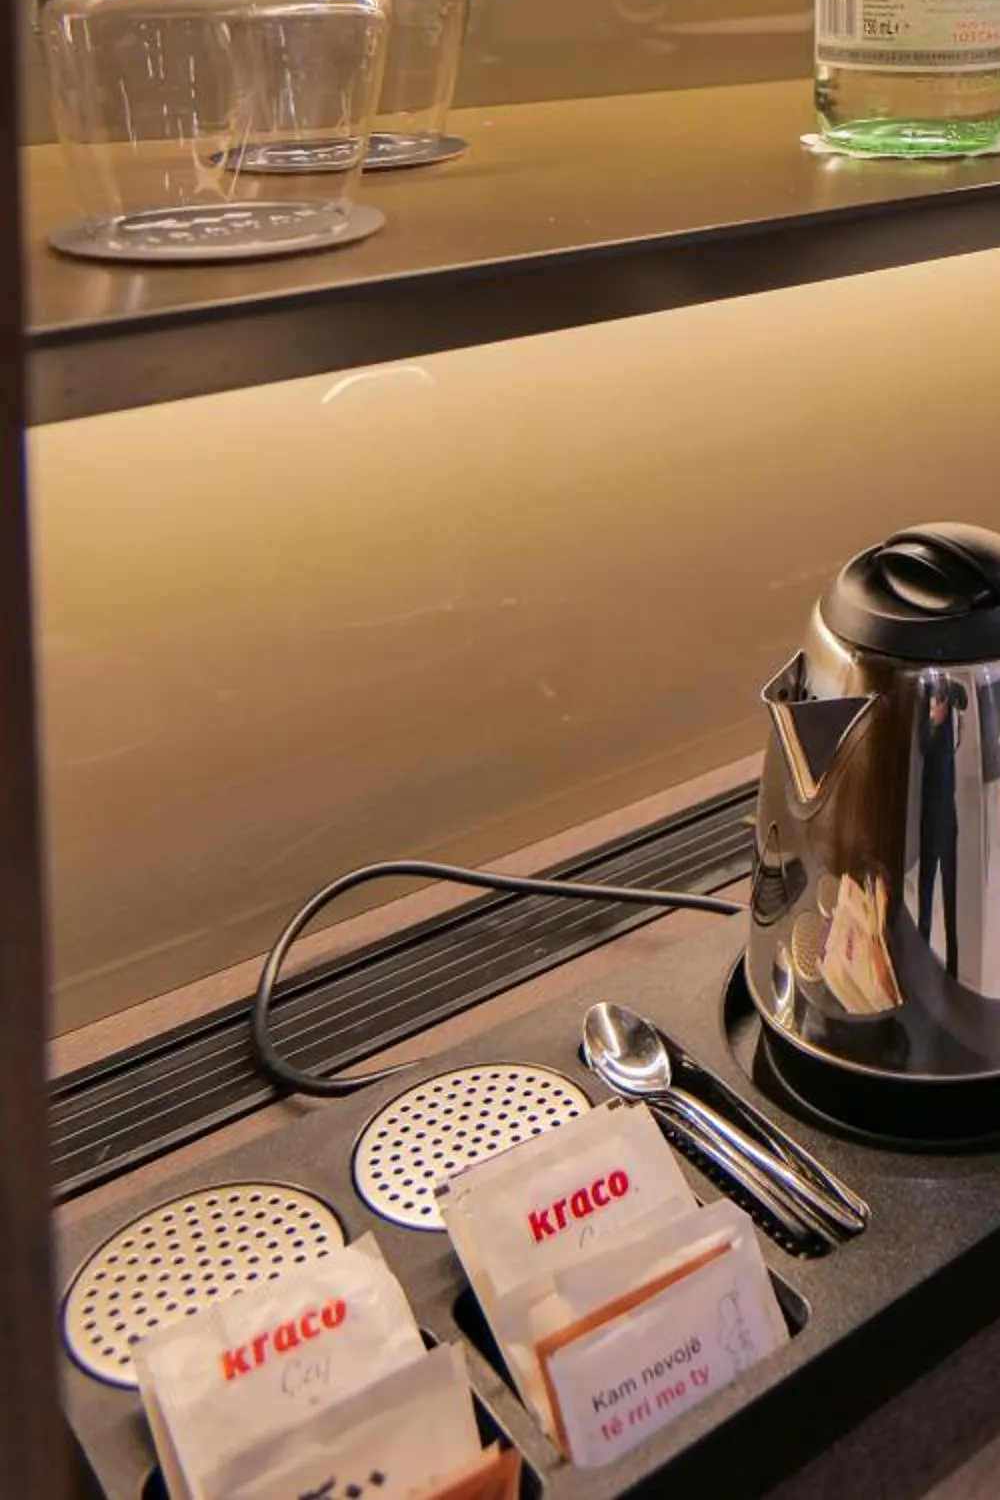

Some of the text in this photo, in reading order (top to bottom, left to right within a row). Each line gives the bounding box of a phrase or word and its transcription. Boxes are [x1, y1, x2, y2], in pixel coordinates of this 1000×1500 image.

[527, 1169, 629, 1244] kraco
[220, 1298, 347, 1382] kraco
[591, 1376, 637, 1414] Kam
[655, 1380, 687, 1409] me
[690, 1364, 710, 1386] ty
